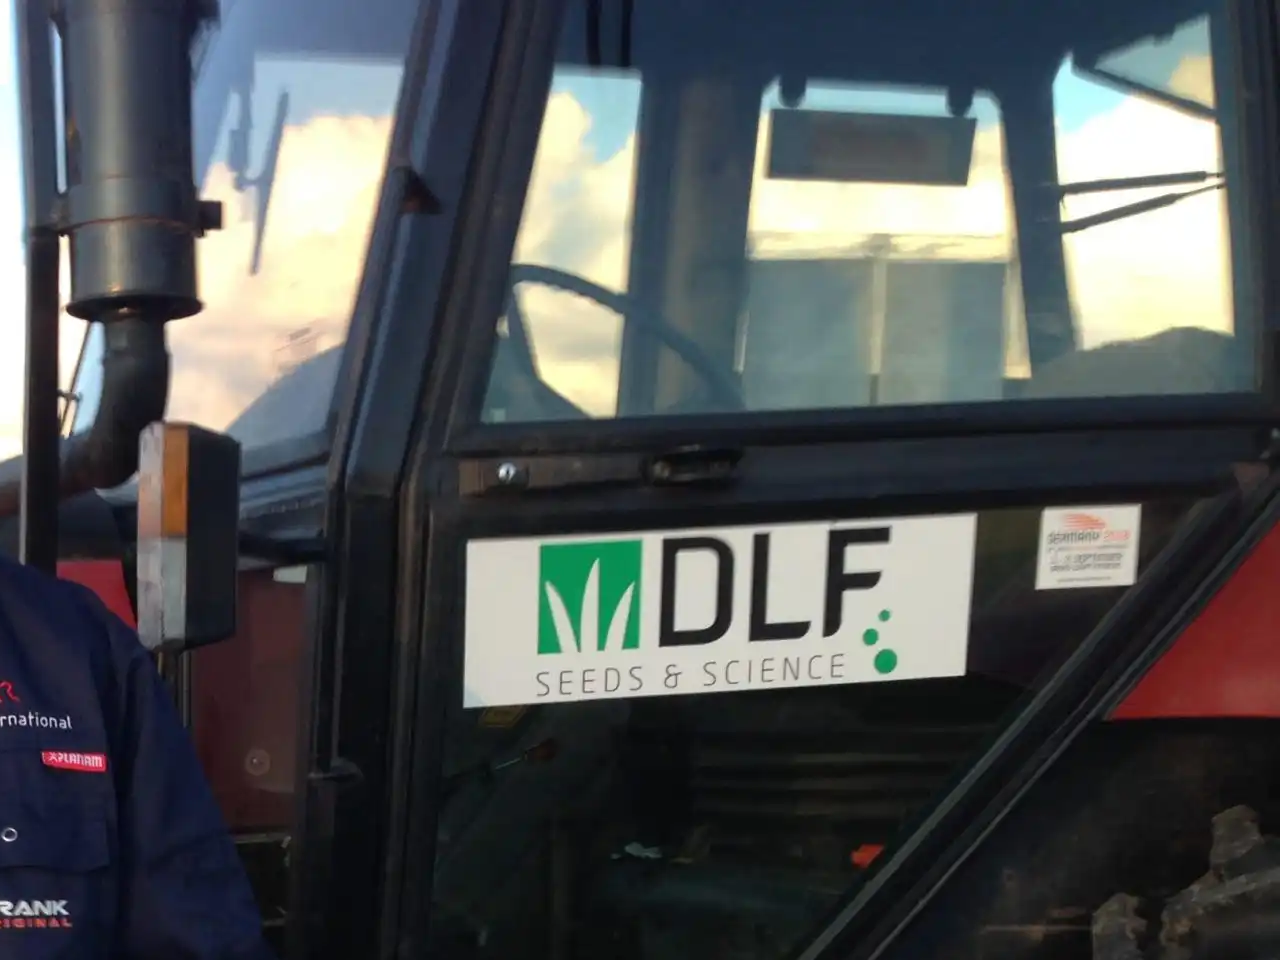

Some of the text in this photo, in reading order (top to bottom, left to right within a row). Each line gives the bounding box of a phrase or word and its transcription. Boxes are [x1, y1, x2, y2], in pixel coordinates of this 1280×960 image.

[658, 526, 891, 647] DLF
[535, 653, 847, 697] SEEDS & SCIENCE
